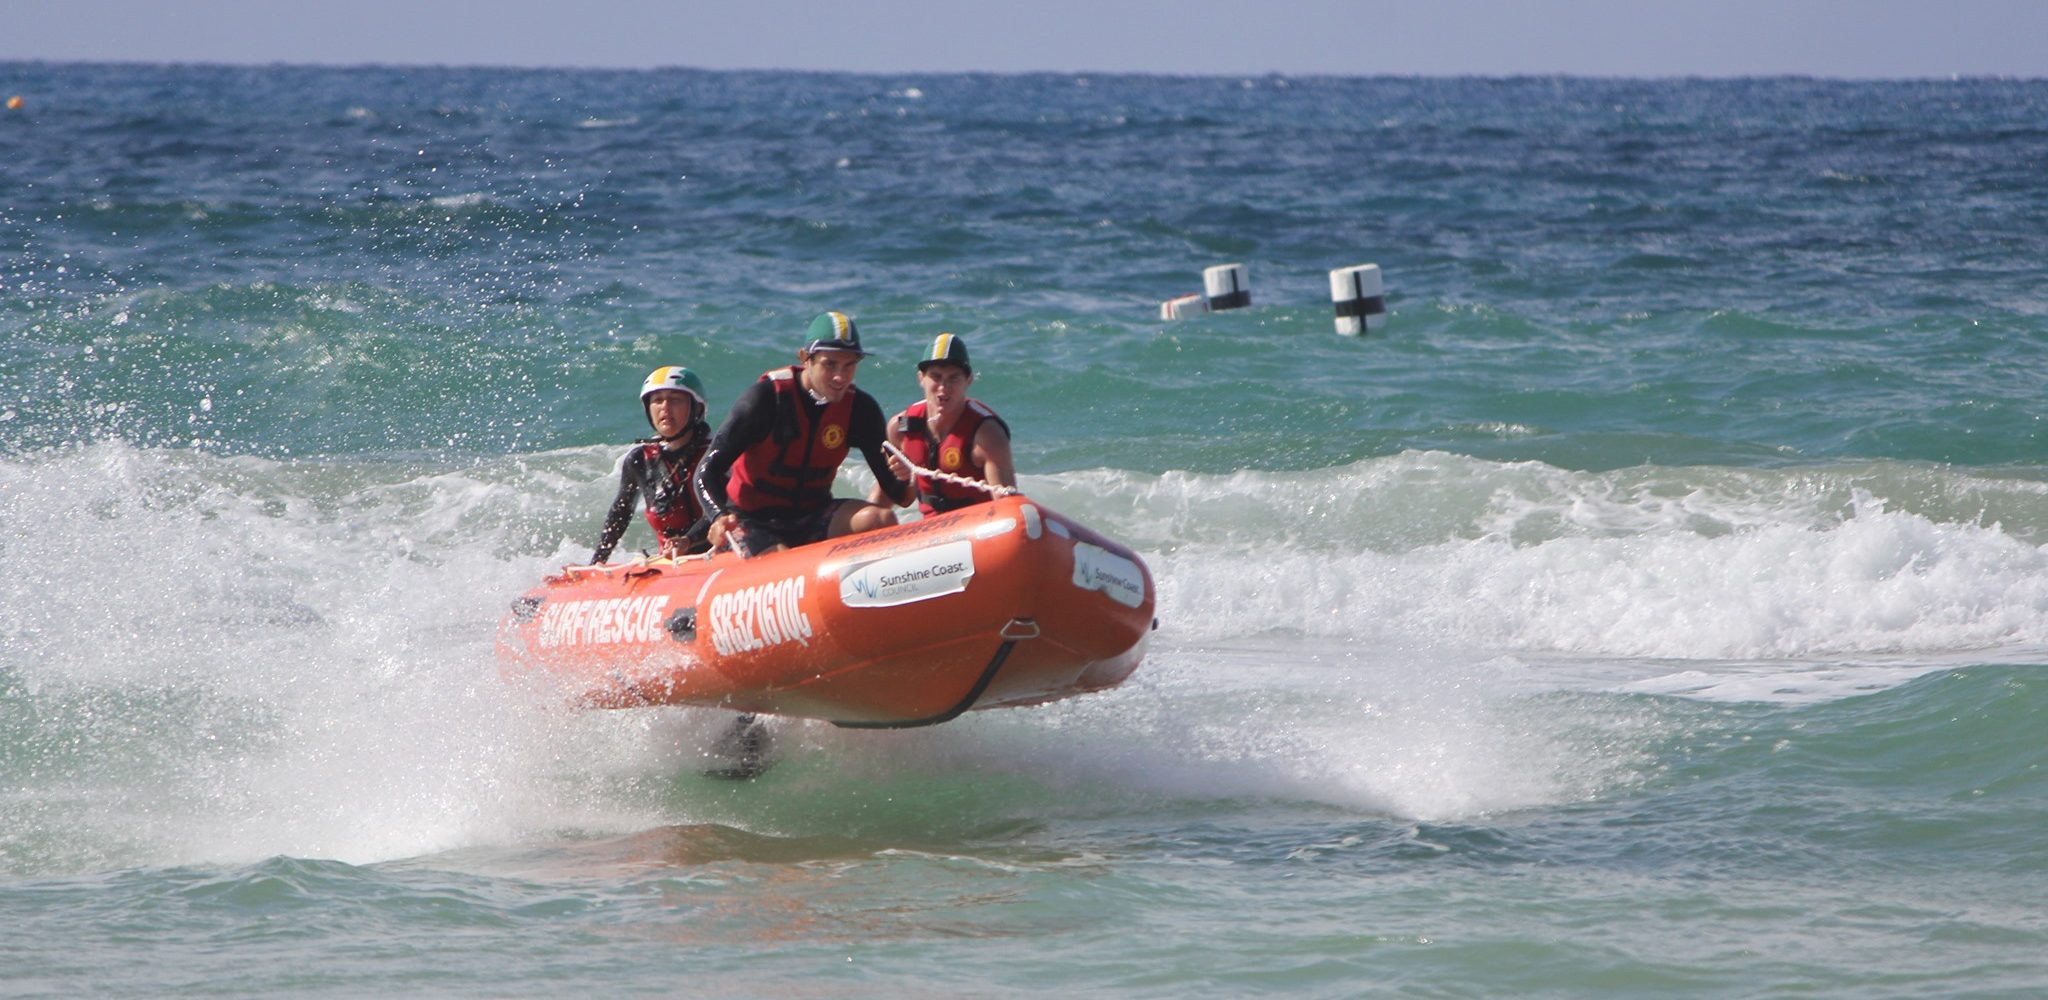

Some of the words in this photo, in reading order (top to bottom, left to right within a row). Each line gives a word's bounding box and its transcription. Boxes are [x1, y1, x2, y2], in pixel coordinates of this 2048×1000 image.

[880, 569, 930, 588] Sunshine
[931, 562, 966, 577] Coast
[587, 595, 670, 644] RESCUE
